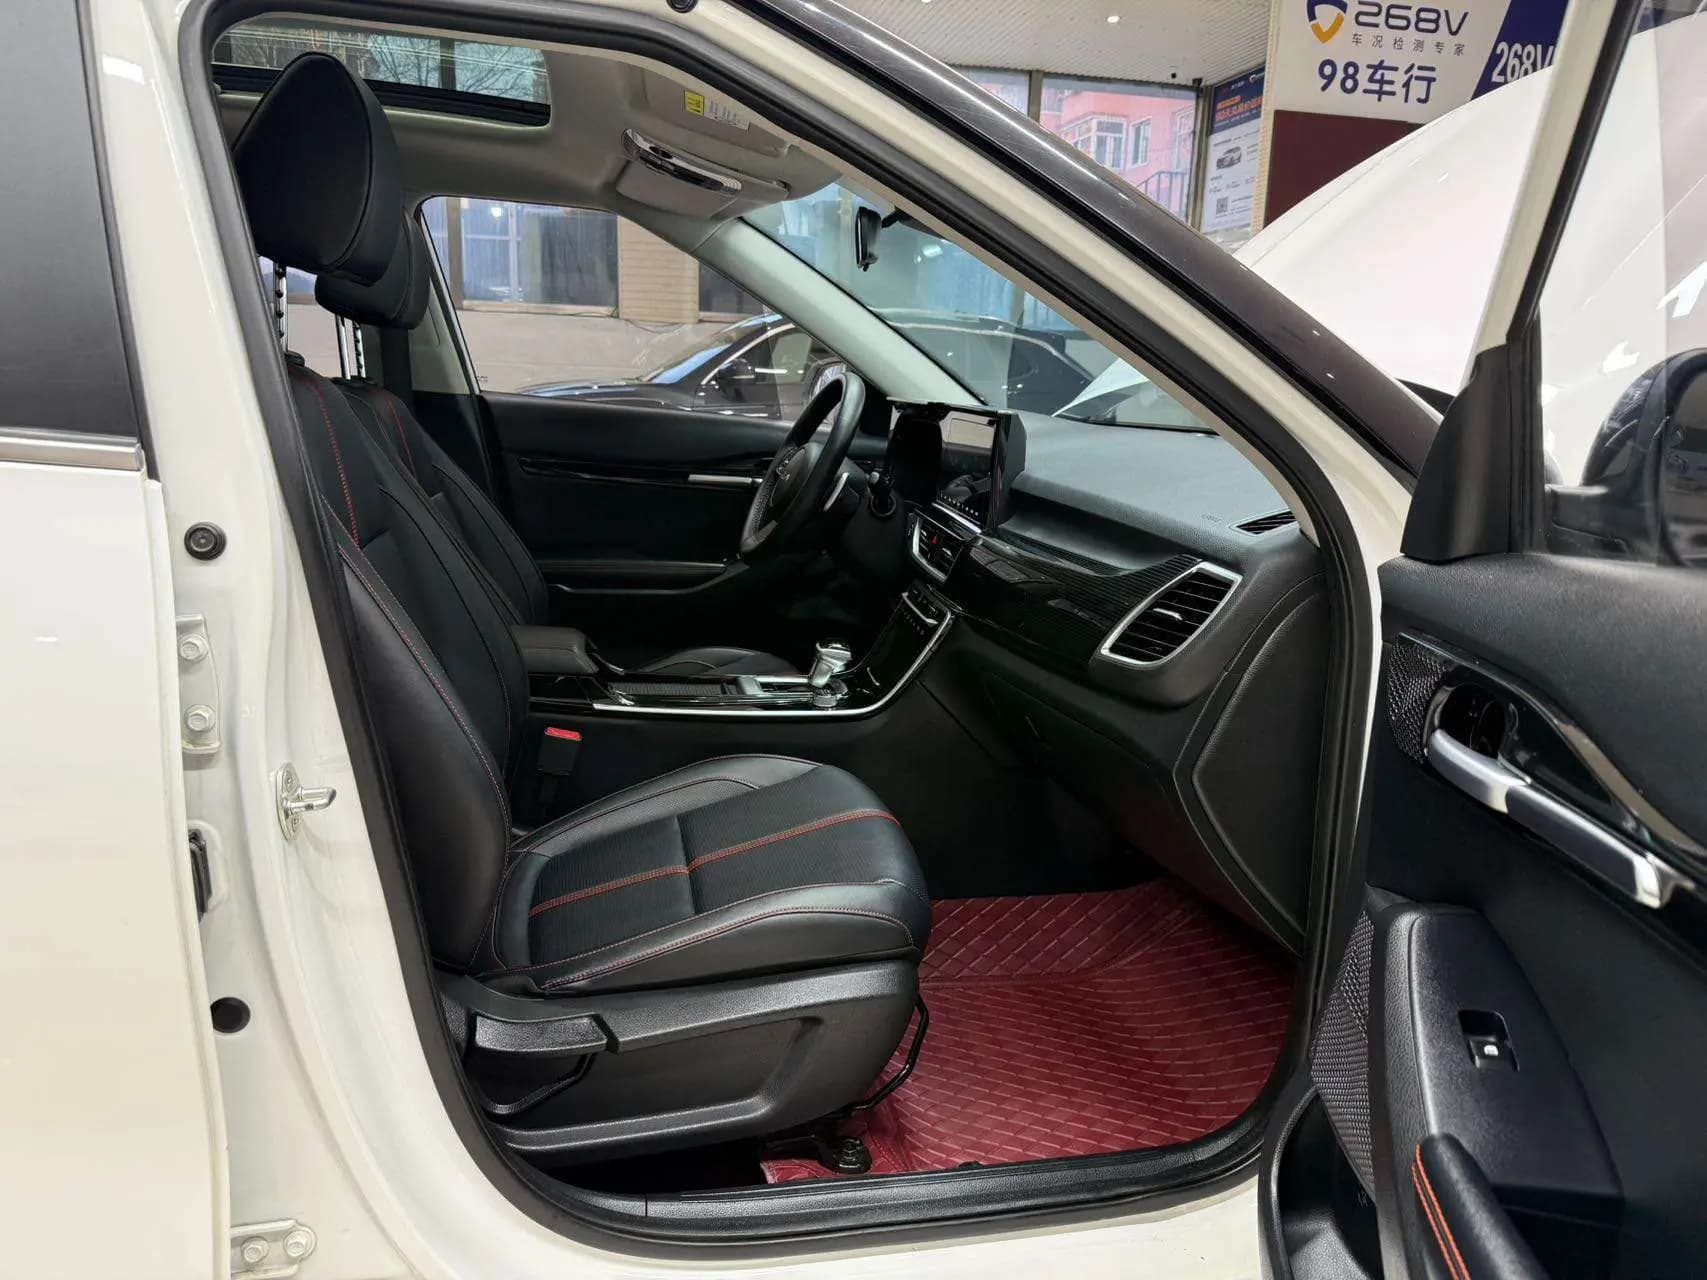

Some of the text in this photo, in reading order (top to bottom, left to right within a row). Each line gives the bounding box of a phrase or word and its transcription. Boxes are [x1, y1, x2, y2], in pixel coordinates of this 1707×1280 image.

[1354, 1, 1469, 36] 268V
[1352, 33, 1465, 56] 车况检测专家
[1491, 41, 1554, 83] 268V
[1318, 59, 1437, 104] 98车行
